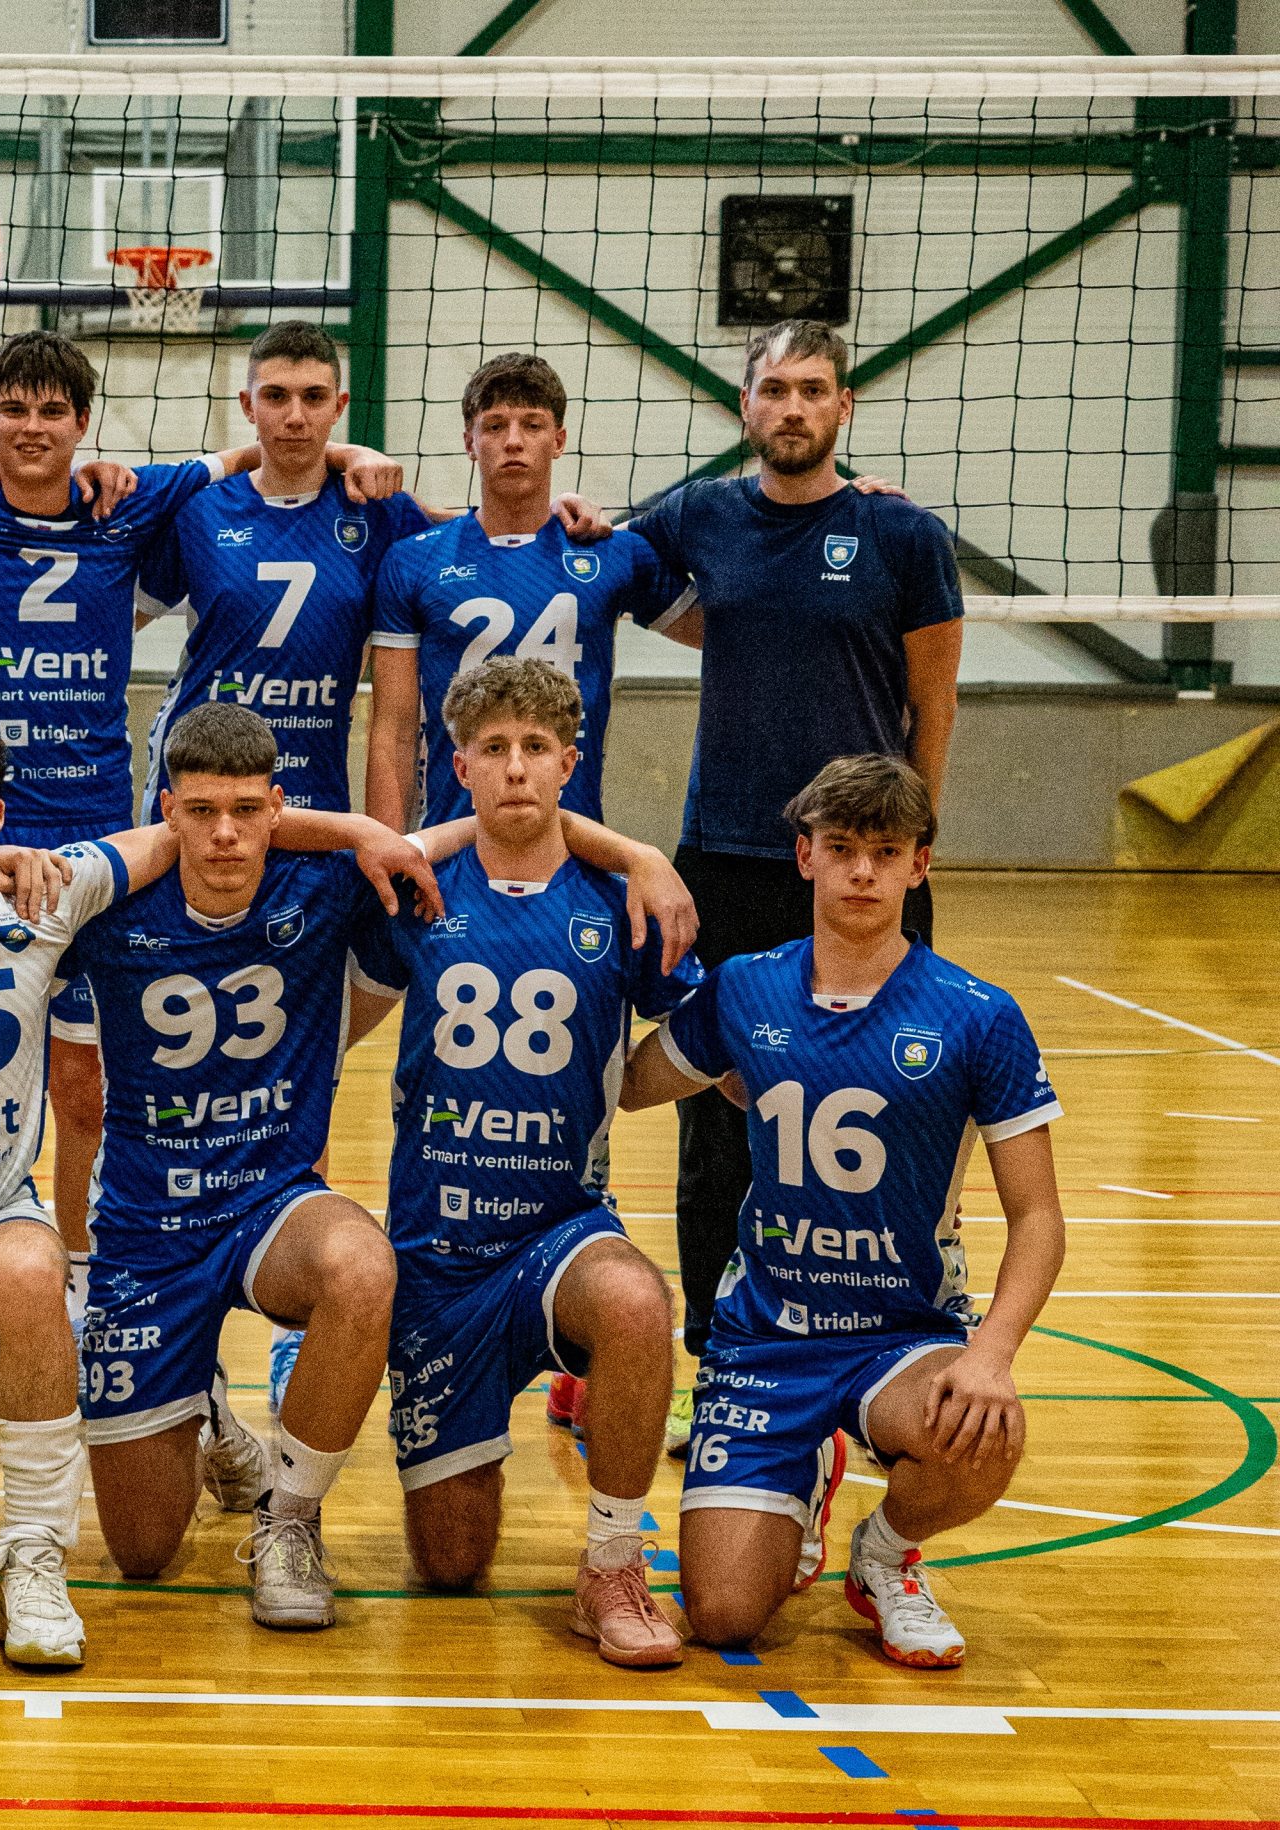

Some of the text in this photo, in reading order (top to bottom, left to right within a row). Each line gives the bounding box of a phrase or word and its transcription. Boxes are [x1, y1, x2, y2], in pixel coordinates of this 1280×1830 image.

[18, 547, 79, 622] 2
[256, 561, 317, 648] 7
[448, 592, 583, 679] 24
[29, 688, 106, 702] ventilation
[32, 724, 90, 744] triglav
[265, 716, 333, 729] entilation
[273, 752, 310, 773] glav
[141, 964, 288, 1070] 93
[433, 962, 578, 1077] 88
[752, 1023, 793, 1046] FACE
[145, 1122, 291, 1150] Smart ventilation
[755, 1080, 889, 1194] 16
[422, 1144, 574, 1172] Smart ventilation
[205, 1167, 267, 1191] triglav
[474, 1196, 545, 1221] triglav
[808, 1271, 911, 1289] ventilation
[89, 1360, 135, 1404] 93
[715, 1370, 780, 1389] triglav
[689, 1432, 732, 1473] 16
